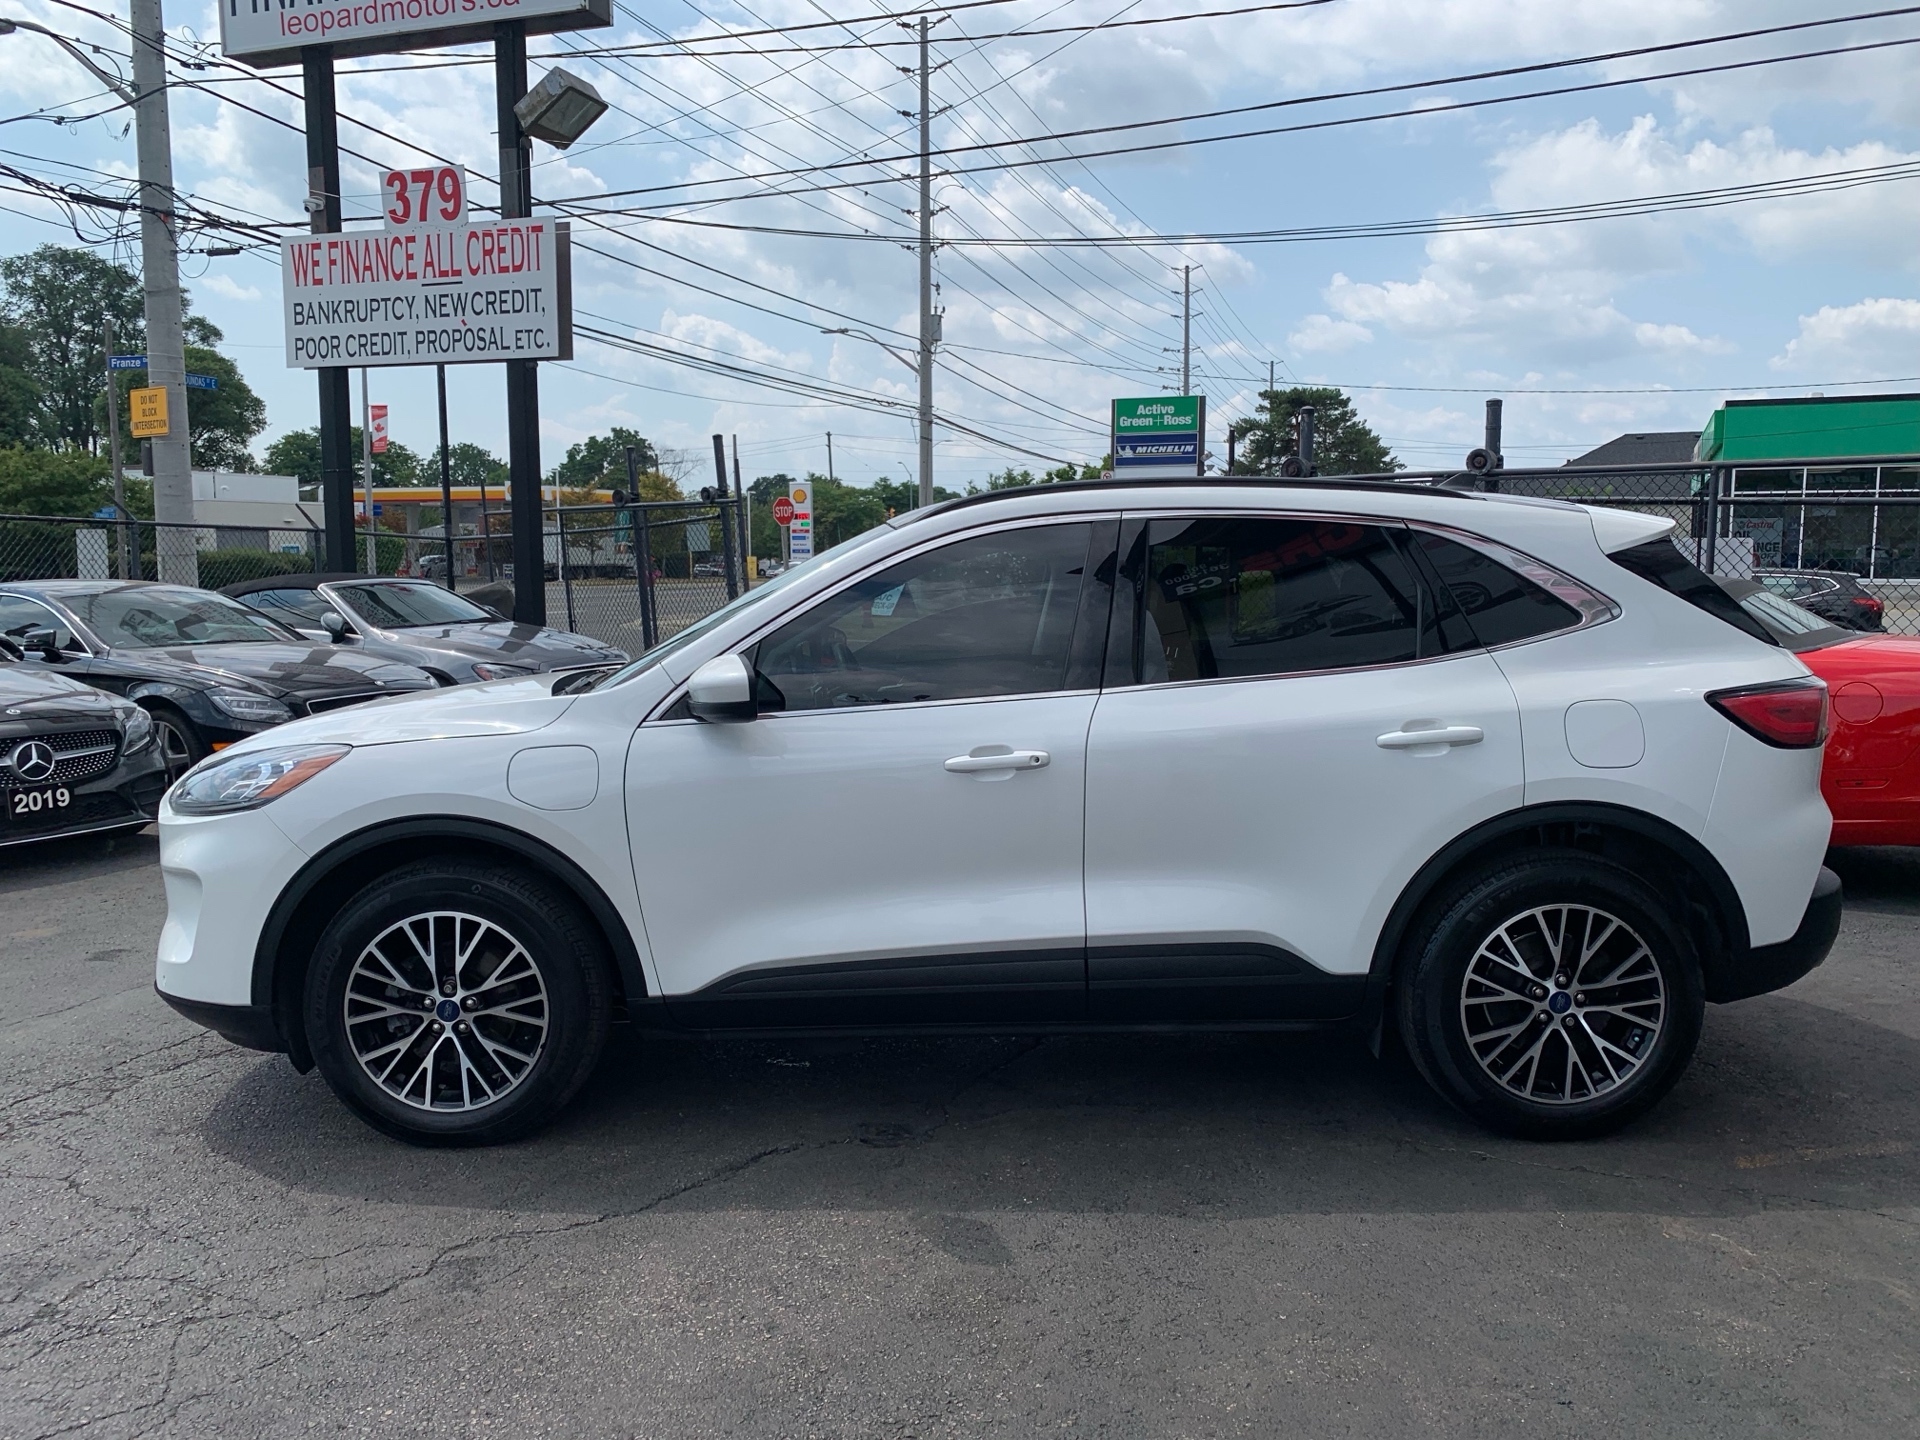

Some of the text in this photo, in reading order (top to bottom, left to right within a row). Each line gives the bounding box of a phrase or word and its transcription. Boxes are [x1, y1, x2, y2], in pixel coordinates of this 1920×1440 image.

[386, 168, 462, 224] 379
[290, 224, 544, 287] WE FINANCE ALL CREDIT
[293, 288, 546, 325] BANKRUPTCY, NEW CREDIT,
[294, 335, 341, 361] POOR
[345, 331, 411, 359] CREDIT,
[515, 328, 550, 349] ETC.
[111, 358, 141, 368] Franze
[211, 379, 216, 389] E
[140, 394, 158, 405] DO NOT
[142, 408, 157, 417] BLOCK
[1137, 404, 1175, 415] Active
[133, 420, 167, 431] INTERSECTION
[1135, 445, 1194, 454] MICHELIN
[775, 506, 793, 517] STOP
[13, 788, 71, 814] 2019
